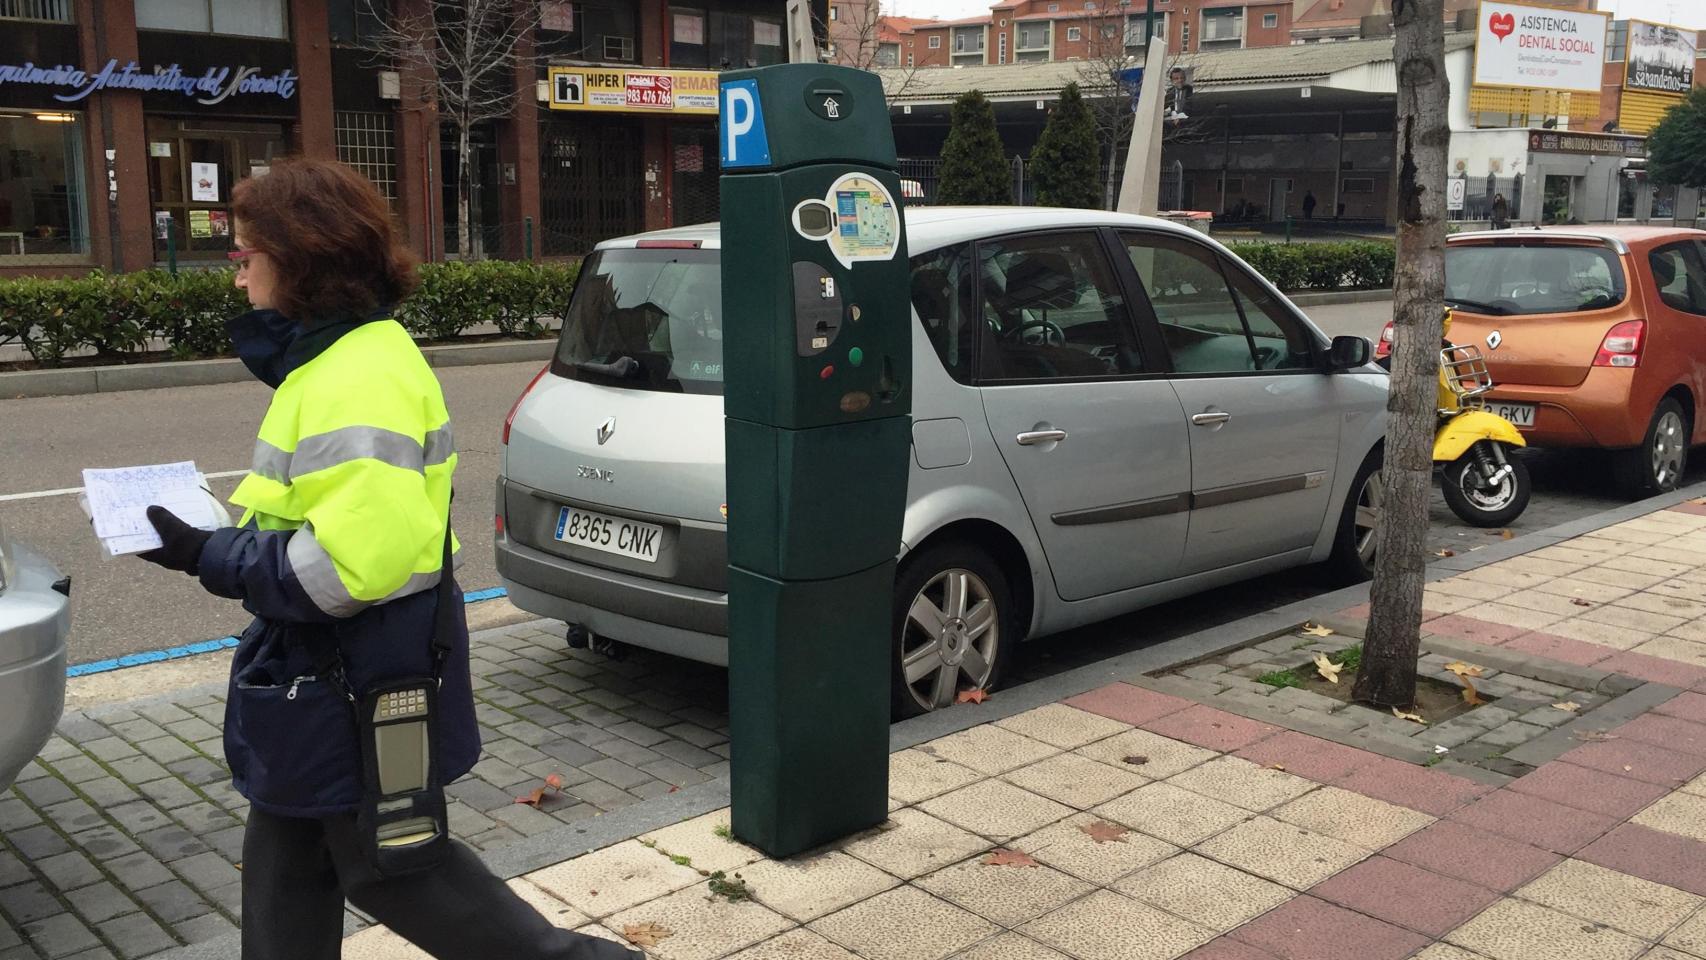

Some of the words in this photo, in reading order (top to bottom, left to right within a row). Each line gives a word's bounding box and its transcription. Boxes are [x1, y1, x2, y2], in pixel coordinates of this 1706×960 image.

[1520, 15, 1577, 33] ASISTENCIA
[1519, 34, 1556, 50] DENTAL
[1559, 38, 1595, 54] SOCIAL
[586, 74, 619, 88] HIPER
[627, 89, 640, 102] 983
[642, 90, 656, 103] 476
[657, 91, 671, 104] 766
[726, 87, 755, 161] P
[1500, 406, 1531, 423] GKV
[577, 464, 614, 483] SCENIC
[568, 513, 613, 546] 8365
[618, 523, 658, 557] CNK
